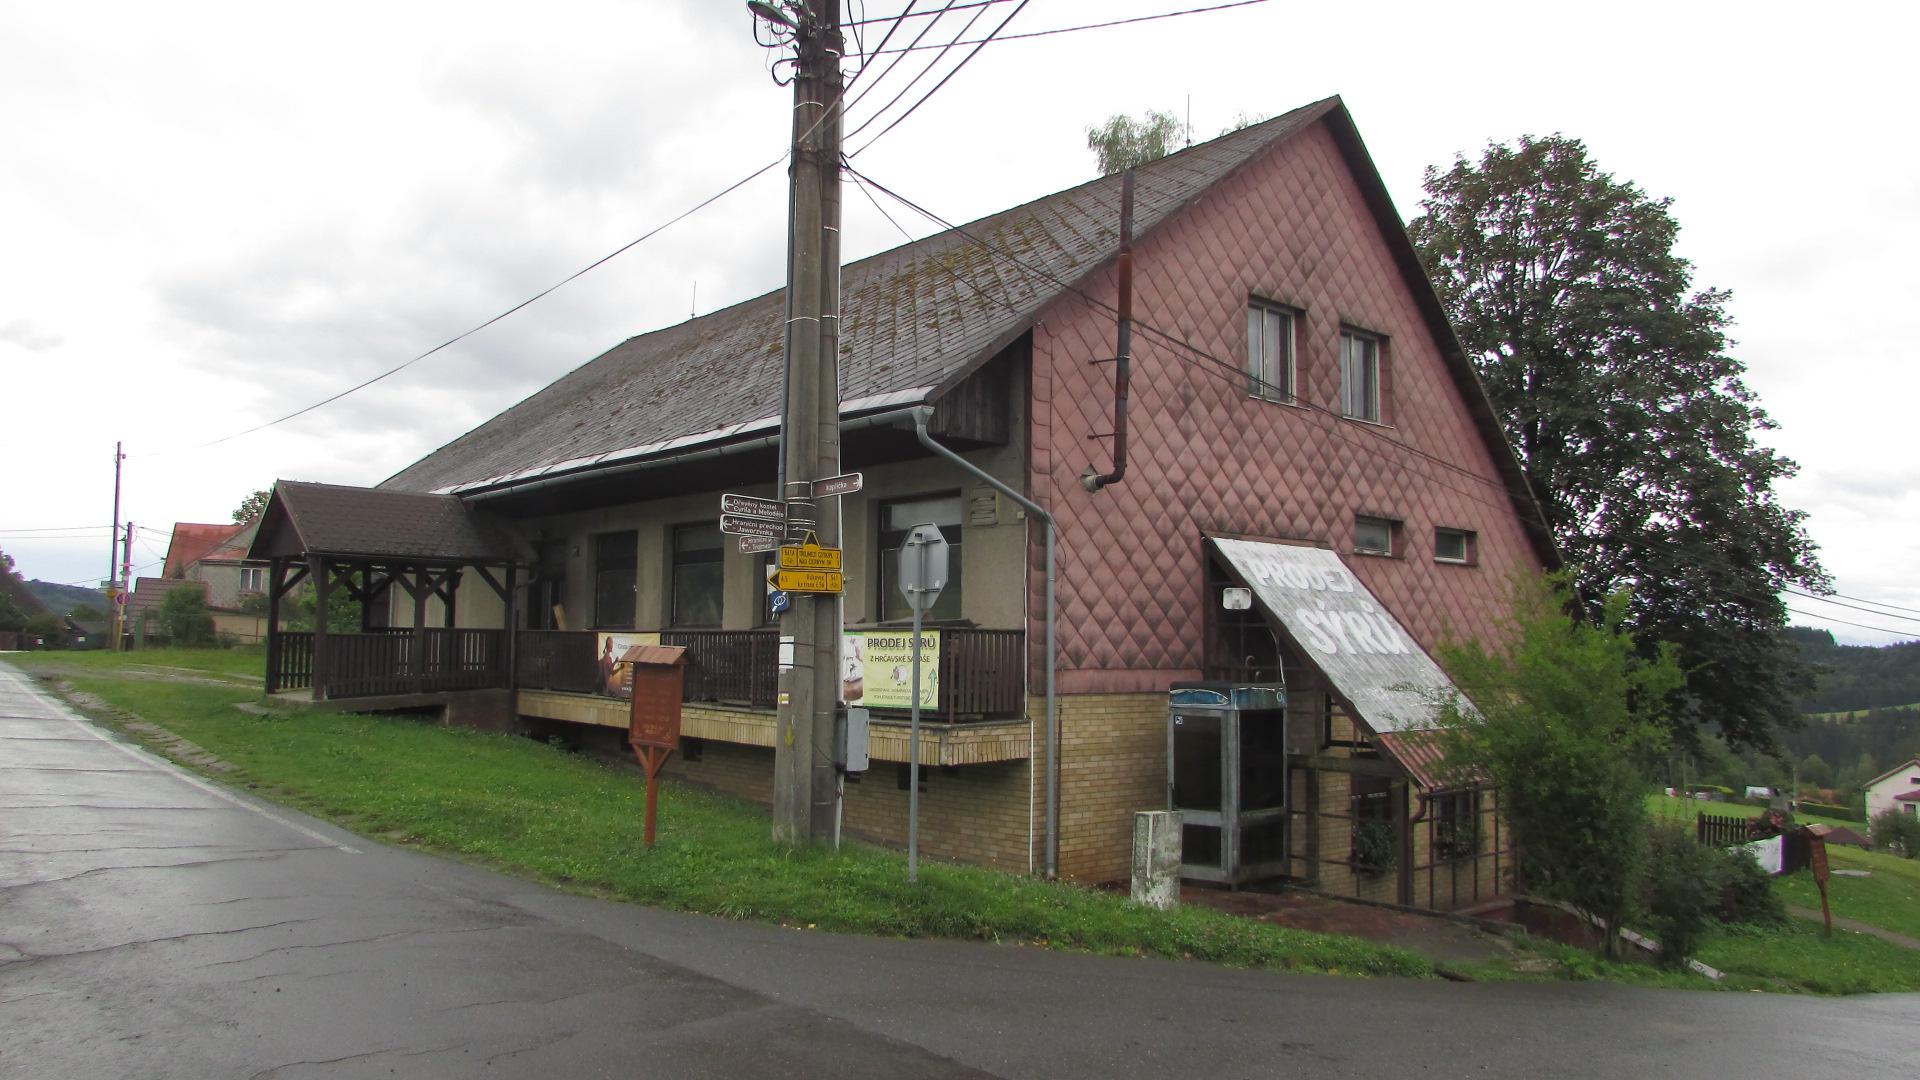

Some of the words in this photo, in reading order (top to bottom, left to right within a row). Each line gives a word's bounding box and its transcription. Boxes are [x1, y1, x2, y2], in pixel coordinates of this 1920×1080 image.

[759, 502, 777, 510] kostel
[1250, 558, 1354, 593] PRODEJ
[1295, 598, 1412, 655] SÝRŮ
[867, 637, 906, 649] PRODEJ
[908, 634, 936, 648] SRŮ
[874, 653, 906, 663] HRČAVSKÉ
